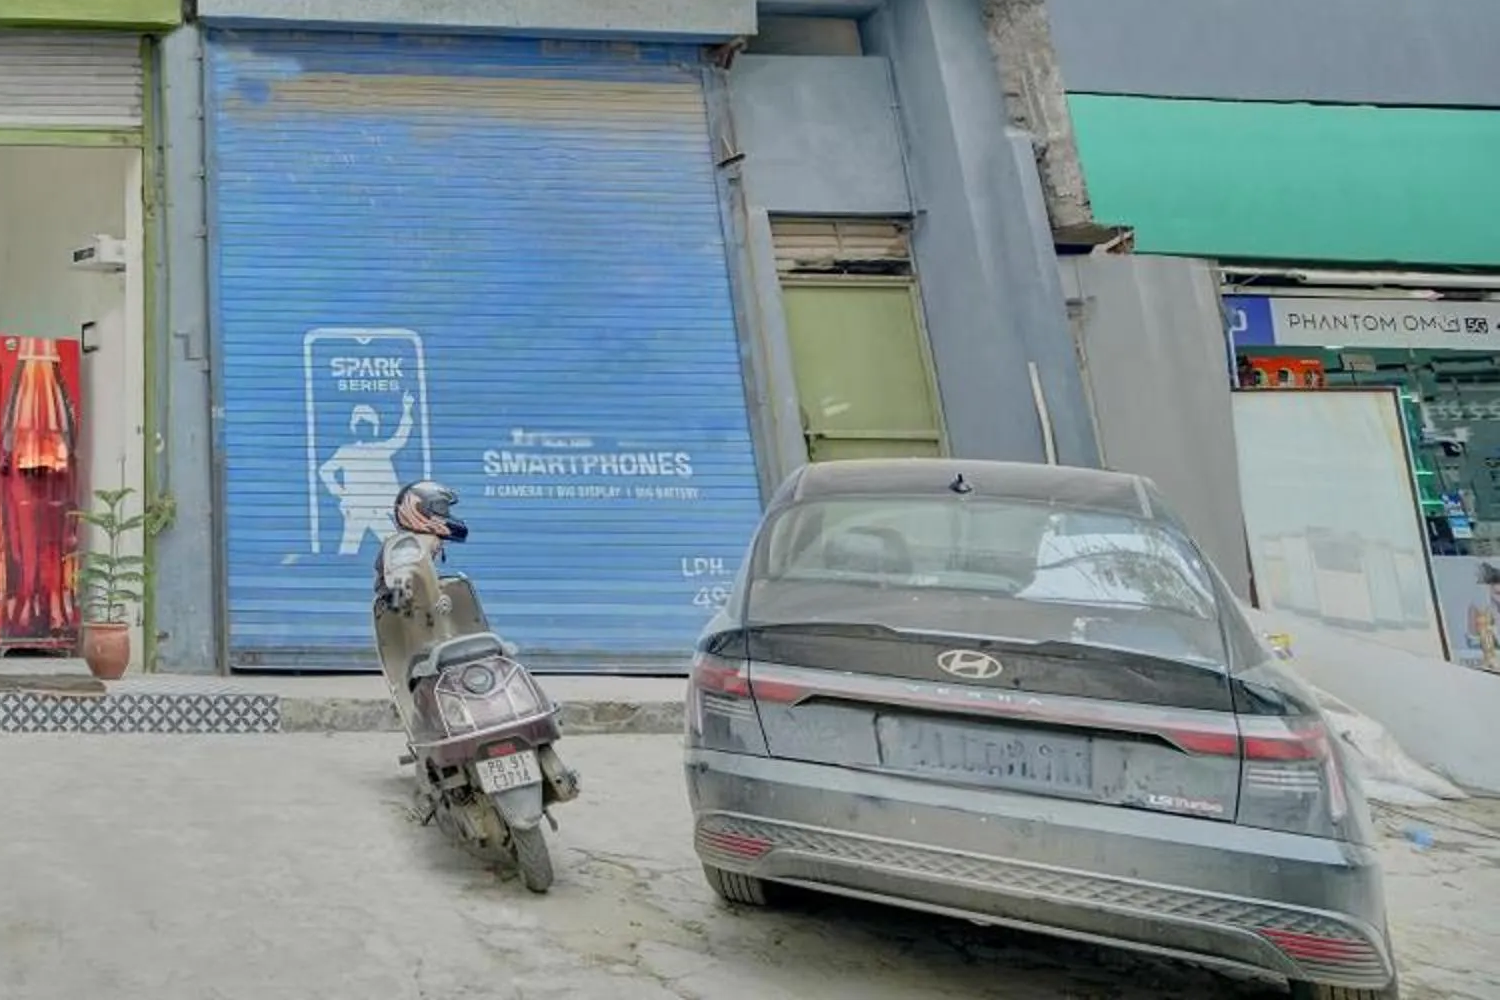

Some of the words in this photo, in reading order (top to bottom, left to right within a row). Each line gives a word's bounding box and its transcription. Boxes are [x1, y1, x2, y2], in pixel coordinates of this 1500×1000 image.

[1287, 313, 1398, 332] PHANTOM
[330, 357, 404, 378] SPARK
[338, 379, 400, 391] SERIES
[483, 450, 693, 477] SMARTPHONES
